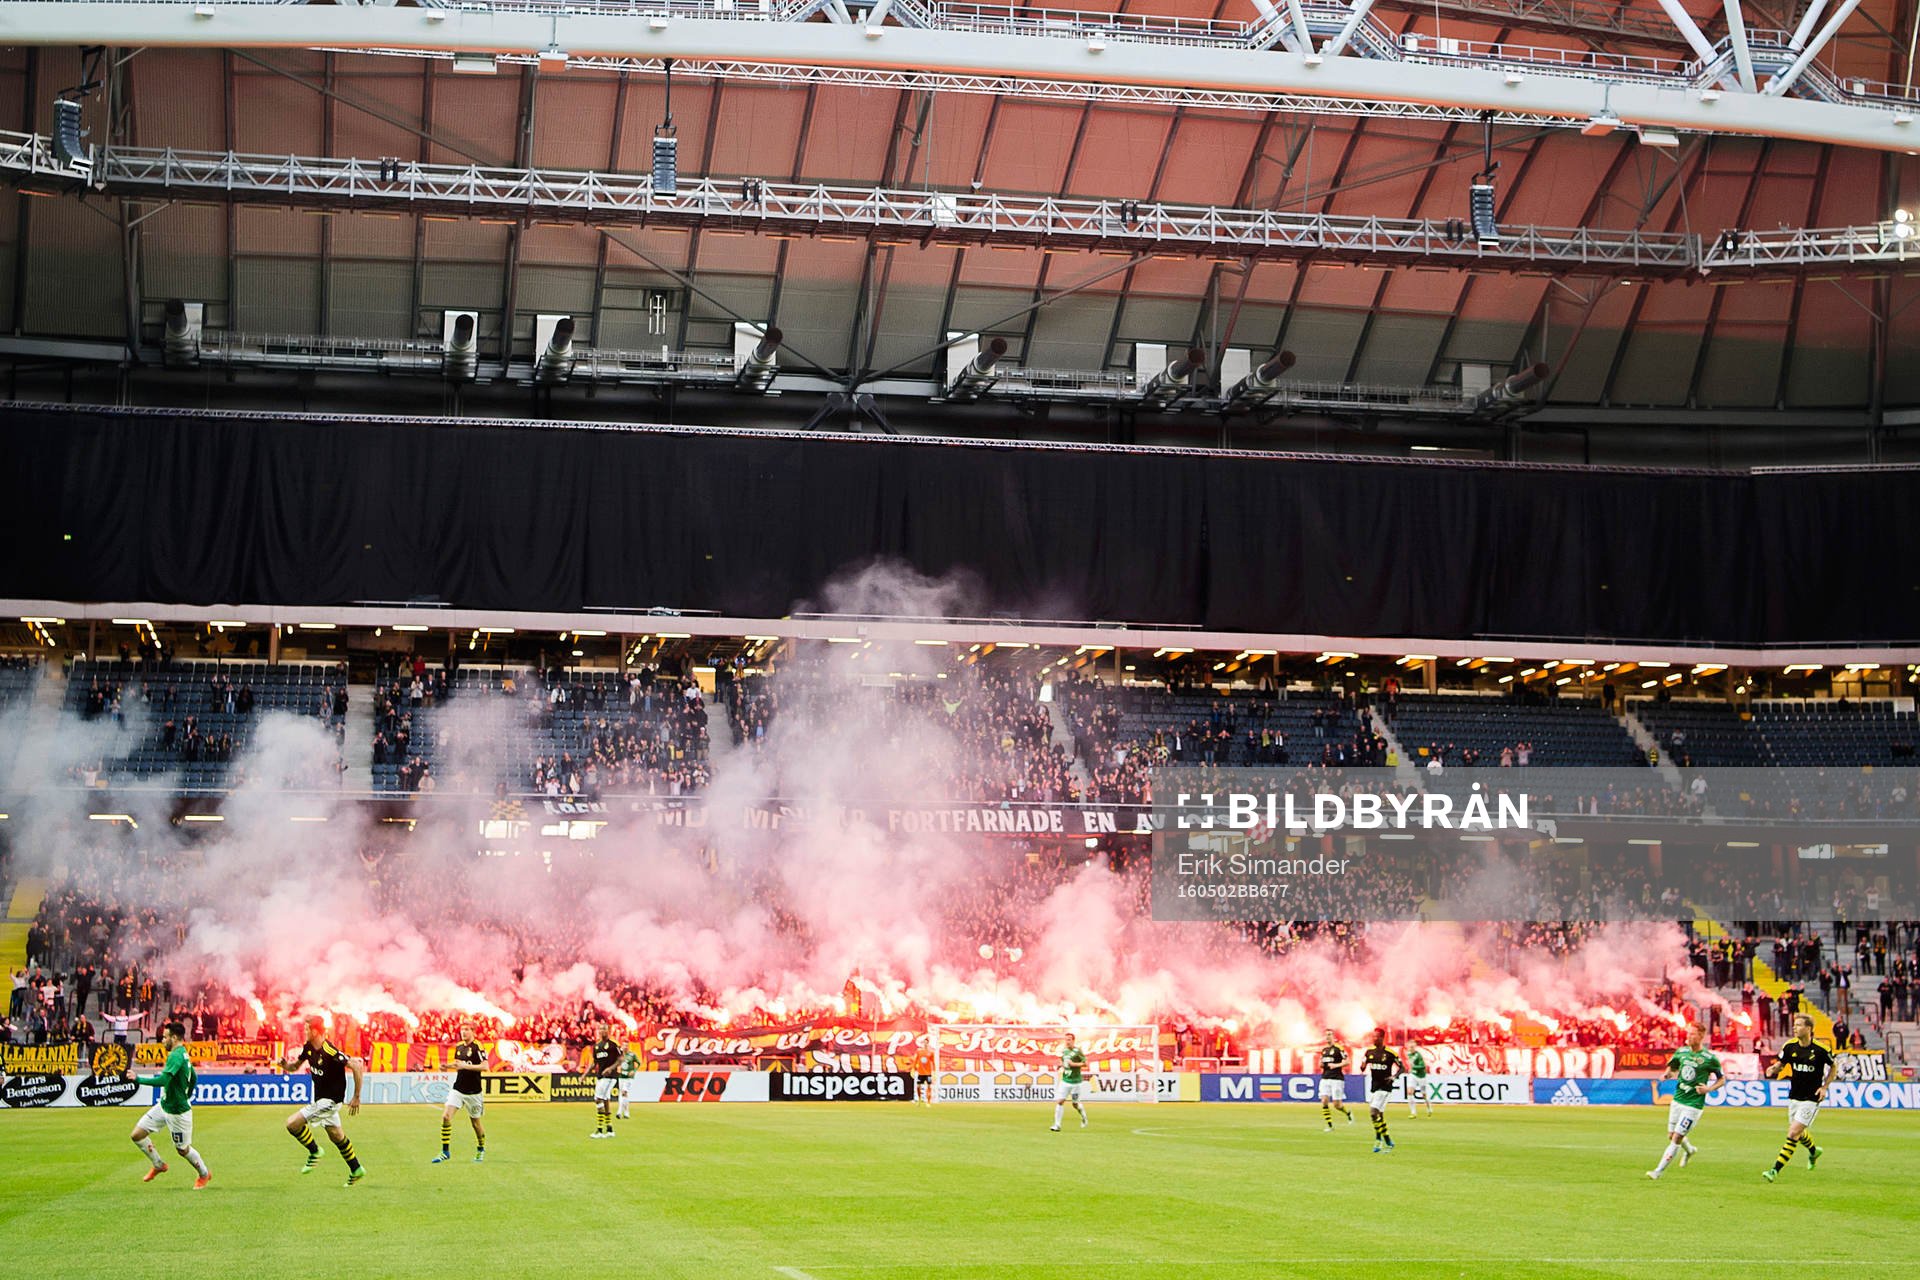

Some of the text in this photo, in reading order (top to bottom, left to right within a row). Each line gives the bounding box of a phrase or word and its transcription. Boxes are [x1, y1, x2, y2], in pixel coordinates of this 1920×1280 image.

[0, 1042, 79, 1064] LLMÄNNA
[6, 1083, 62, 1099] Bengtsson
[80, 1082, 136, 1098] Bengtsson
[157, 1075, 309, 1103] mannia
[481, 1076, 543, 1094] TEX
[783, 1072, 905, 1099] Inspecta
[1099, 1074, 1176, 1093] weber
[1220, 1077, 1347, 1100] MEC
[1705, 1080, 1767, 1107] OSS
